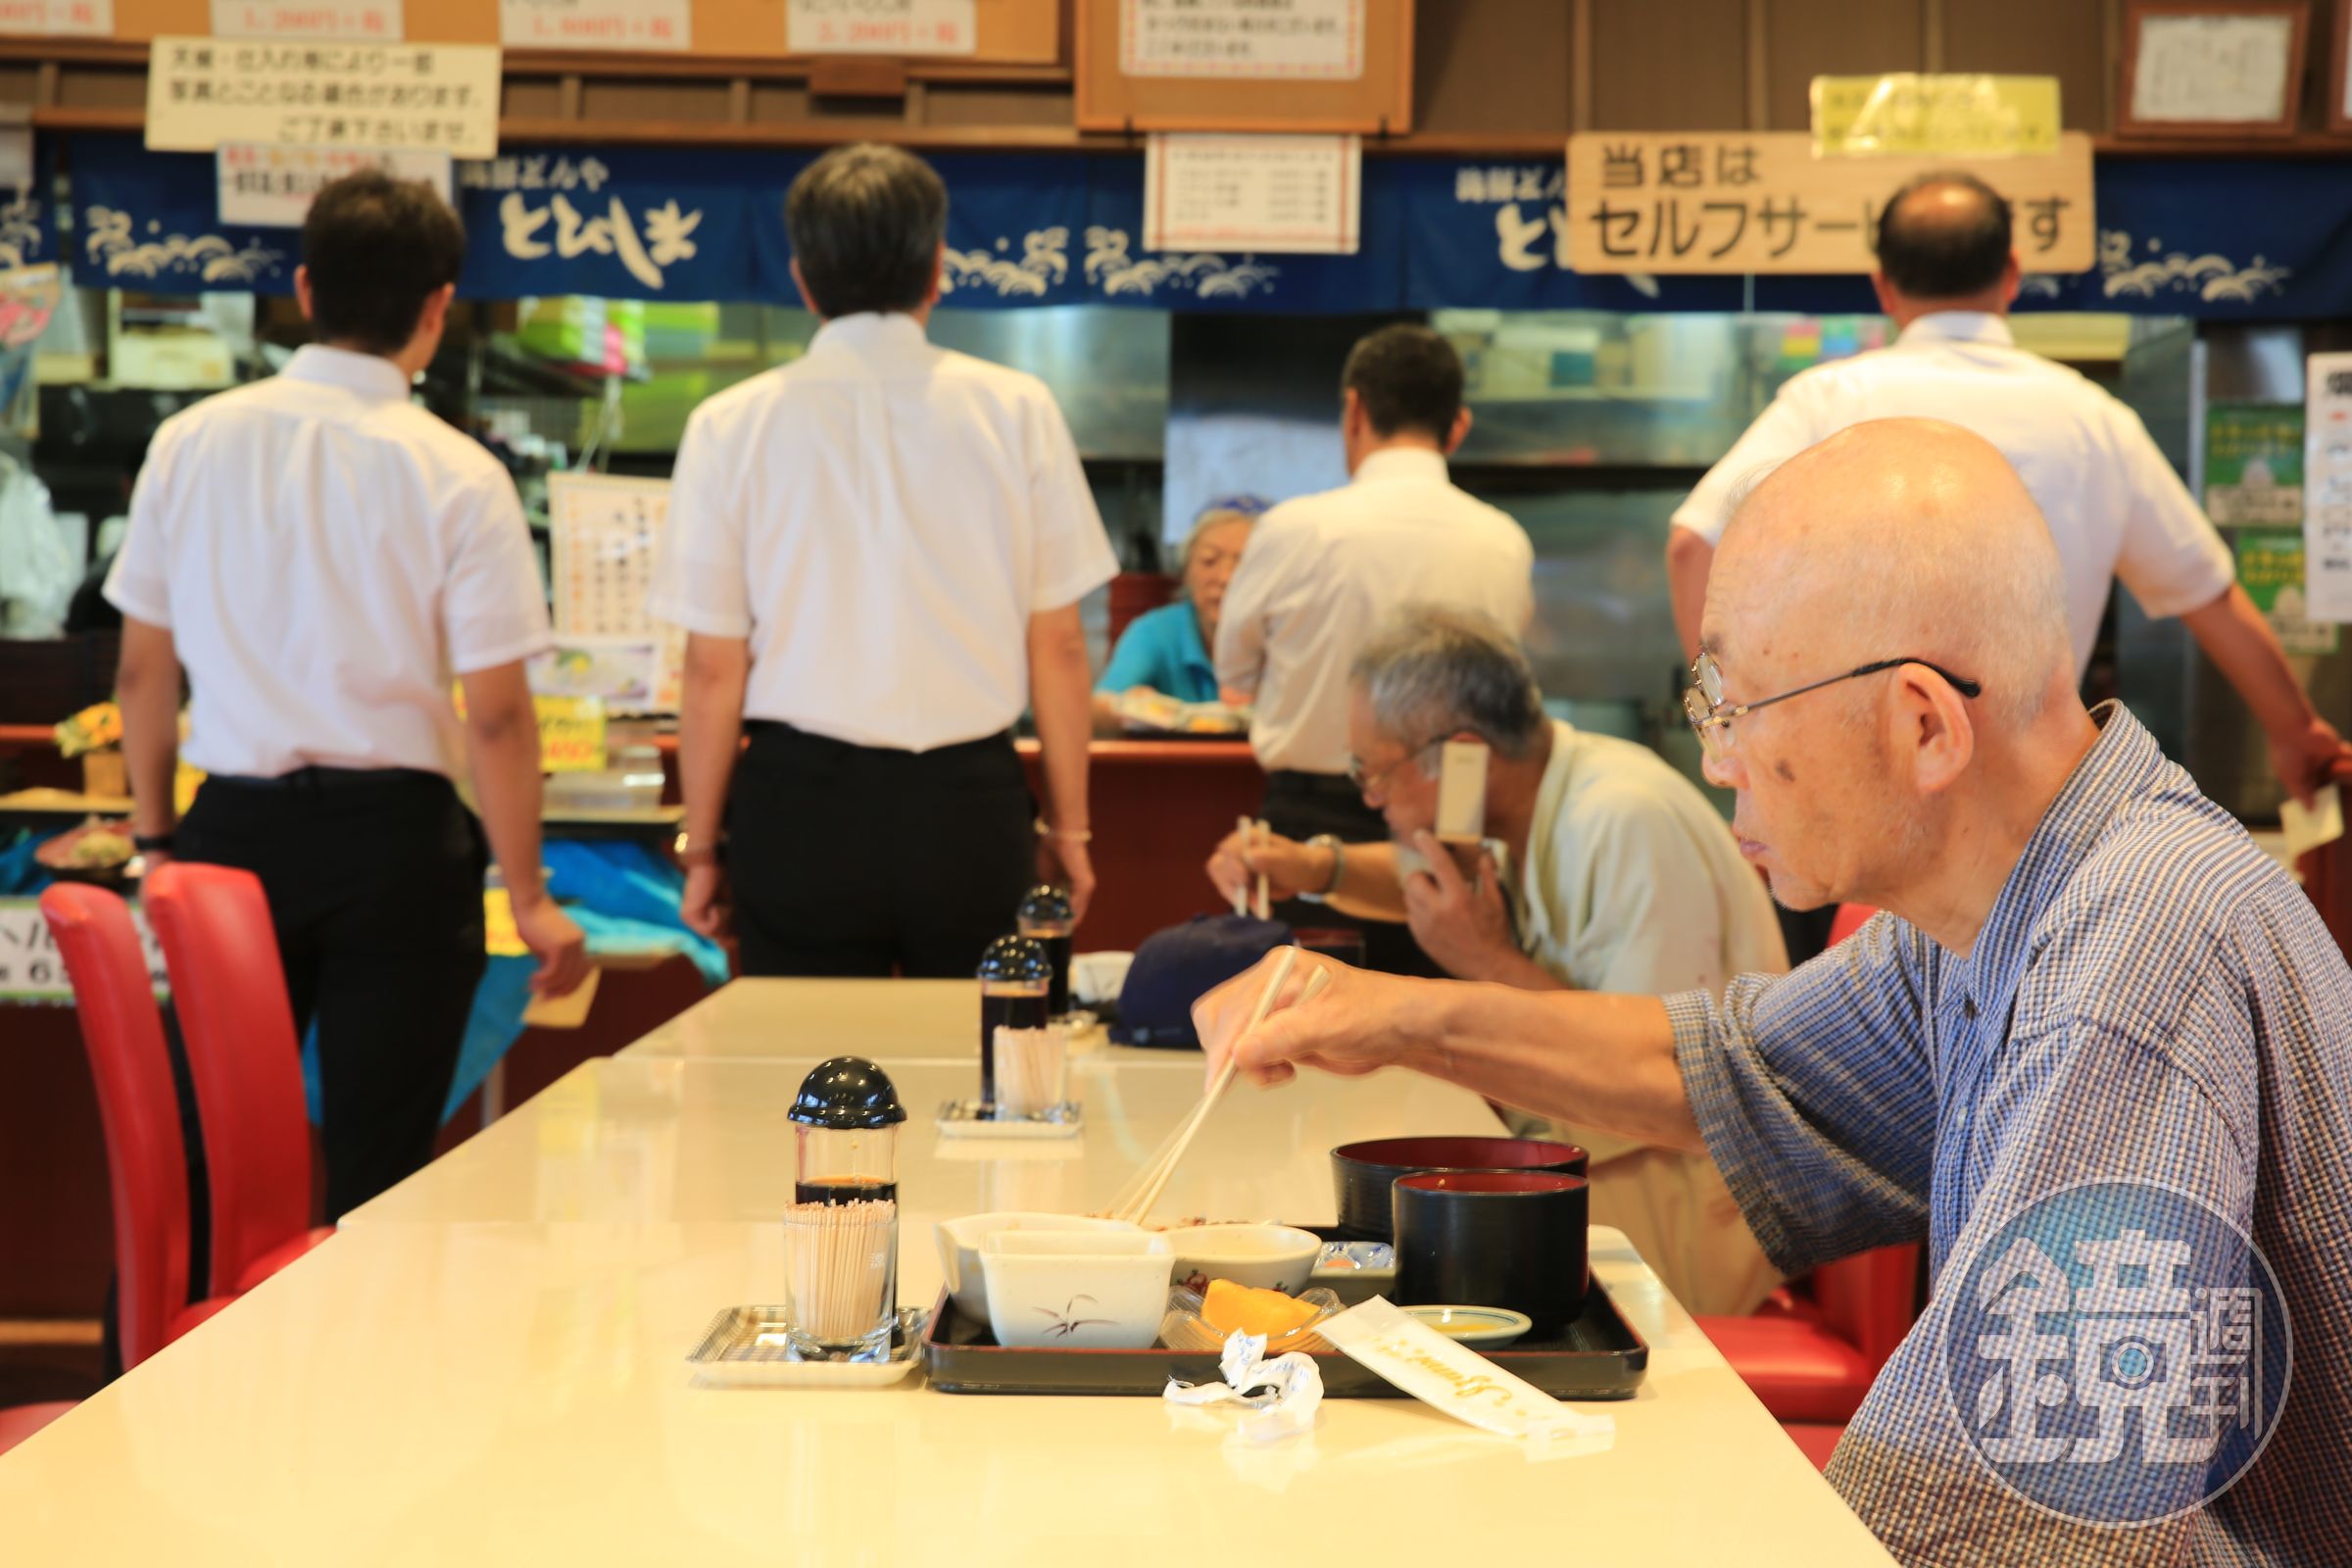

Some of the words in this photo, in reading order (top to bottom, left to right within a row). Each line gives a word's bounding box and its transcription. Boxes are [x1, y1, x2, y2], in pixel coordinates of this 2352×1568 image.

[1601, 144, 1761, 188] 当店は
[1590, 195, 2071, 259] セルフサーす
